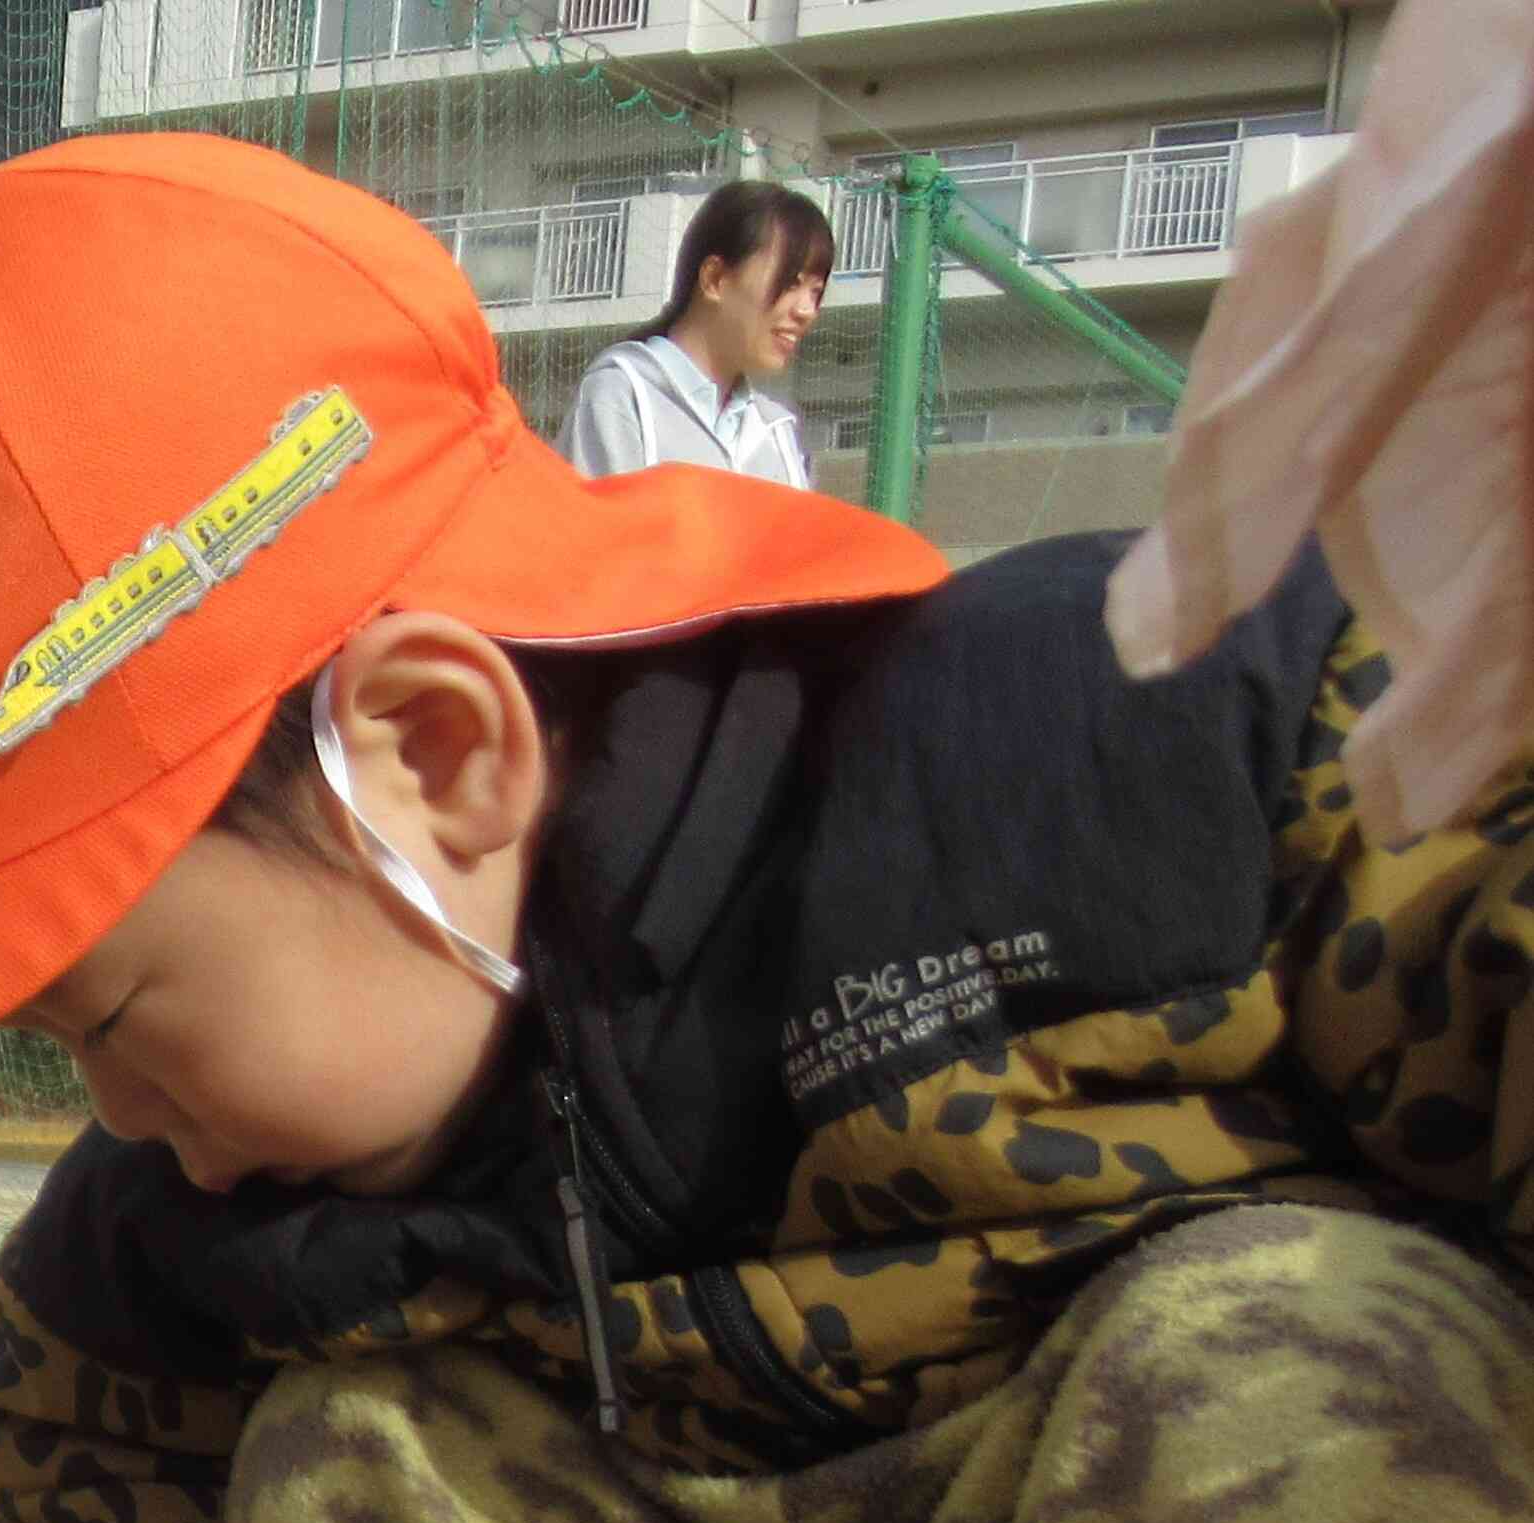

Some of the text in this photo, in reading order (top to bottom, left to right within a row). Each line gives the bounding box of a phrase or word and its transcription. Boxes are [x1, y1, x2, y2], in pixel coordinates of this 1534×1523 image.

[820, 1026, 857, 1056] FOR
[860, 1008, 900, 1037] THE
[904, 968, 995, 1020] POSITIVE
[833, 962, 906, 1021] BIG
[915, 931, 1046, 985] Dream
[880, 1036, 897, 1056] A
[901, 1010, 946, 1045] NEW
[951, 989, 998, 1021] DAY
